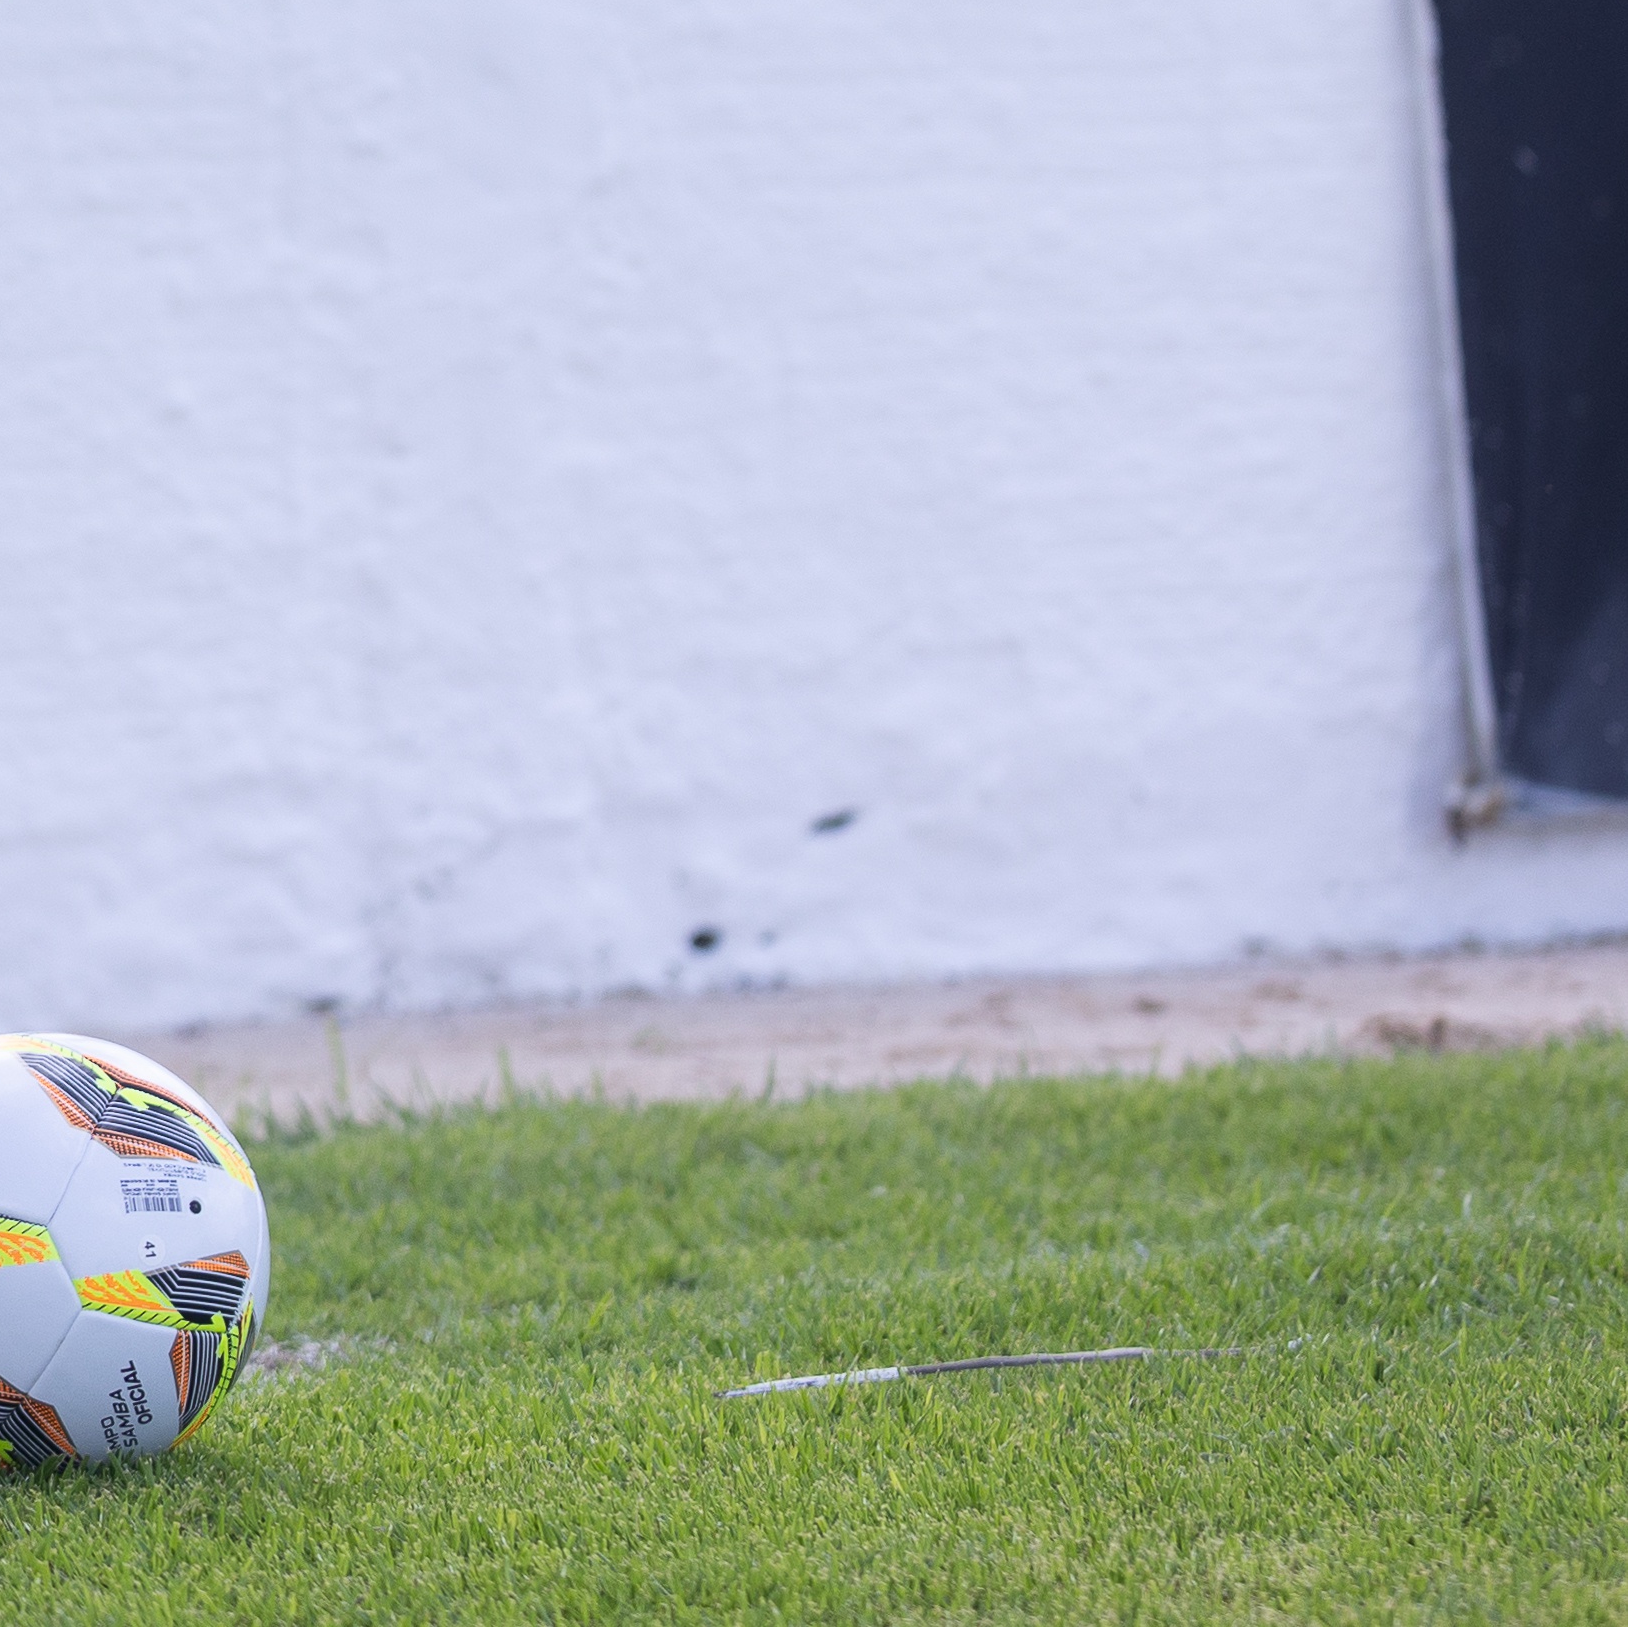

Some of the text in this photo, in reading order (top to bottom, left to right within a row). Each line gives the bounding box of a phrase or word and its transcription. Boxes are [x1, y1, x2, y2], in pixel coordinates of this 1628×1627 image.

[144, 1241, 157, 1258] 41
[120, 1359, 153, 1425] OFICIAL
[100, 1415, 122, 1451] MPO
[109, 1388, 139, 1448] SAMBA
